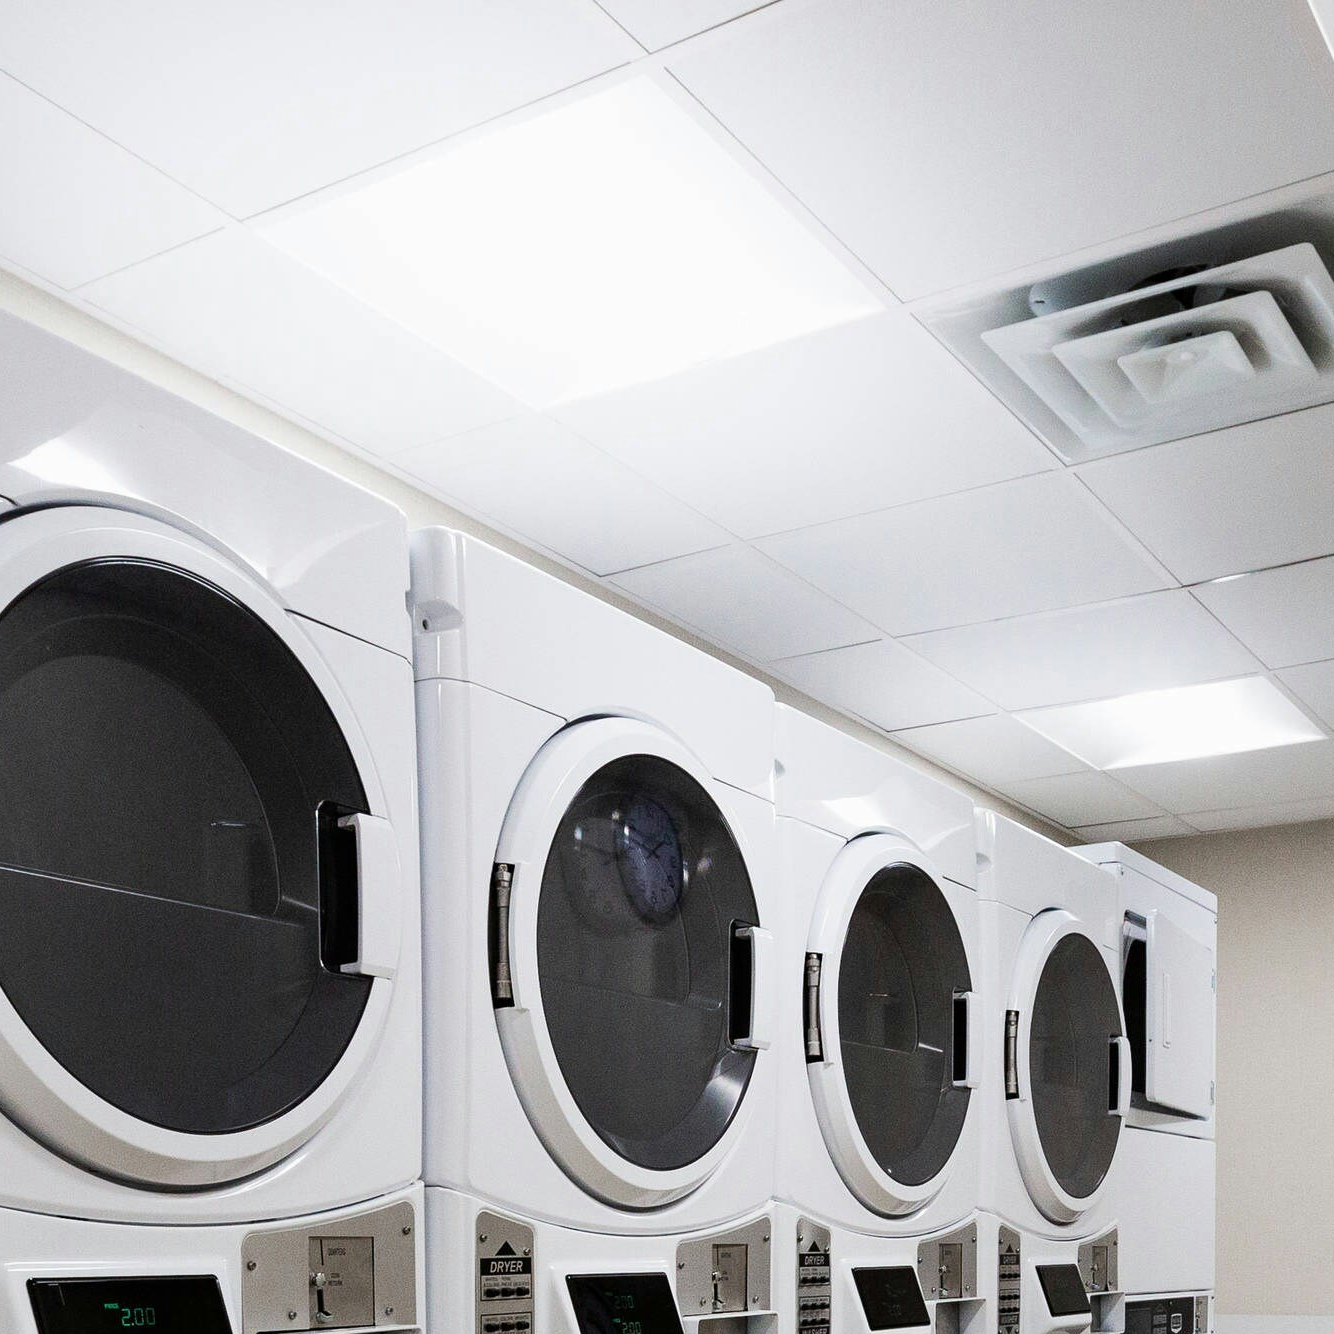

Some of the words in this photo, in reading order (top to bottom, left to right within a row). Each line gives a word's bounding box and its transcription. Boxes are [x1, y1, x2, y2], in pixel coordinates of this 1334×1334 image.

[490, 1260, 524, 1273] DRYER
[804, 1255, 825, 1266] DRYER
[121, 1307, 156, 1327] 2.00
